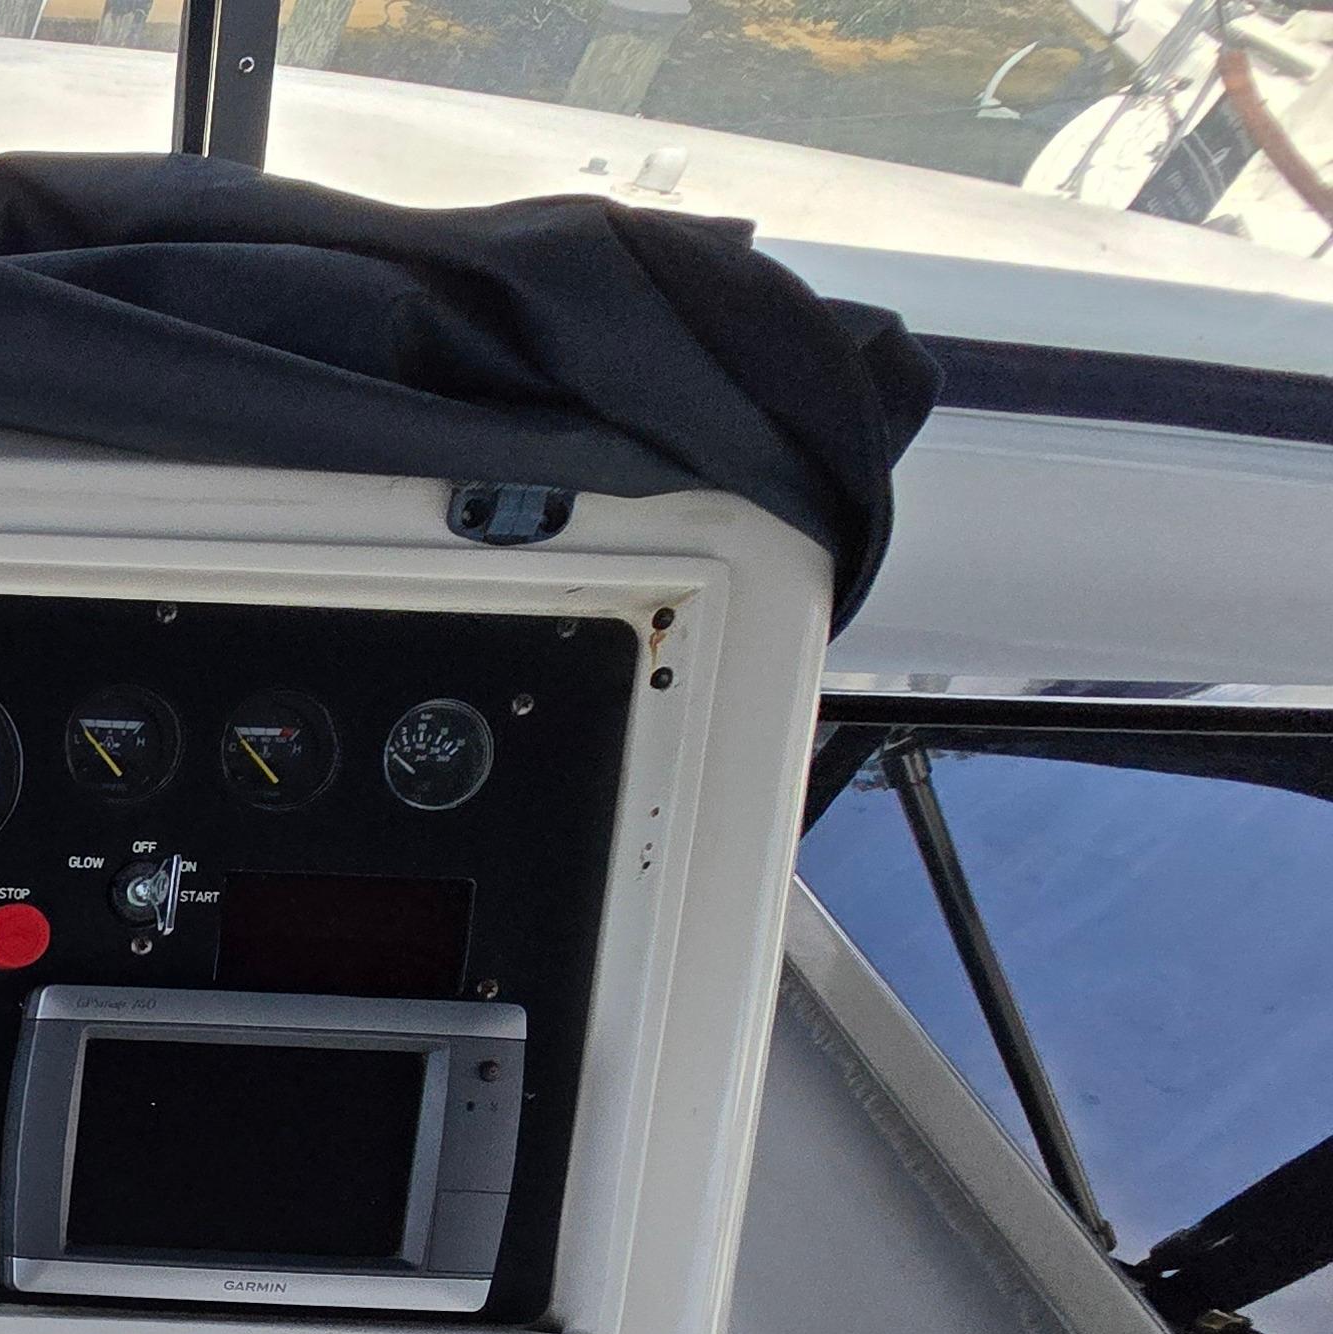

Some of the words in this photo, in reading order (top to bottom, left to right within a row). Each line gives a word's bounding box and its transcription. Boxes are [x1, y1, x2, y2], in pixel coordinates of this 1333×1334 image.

[136, 736, 146, 747] H
[132, 841, 157, 854] OFF
[68, 856, 105, 869] GLOW
[180, 860, 197, 873] ON
[180, 890, 220, 903] START
[223, 1280, 287, 1294] GARMIN
